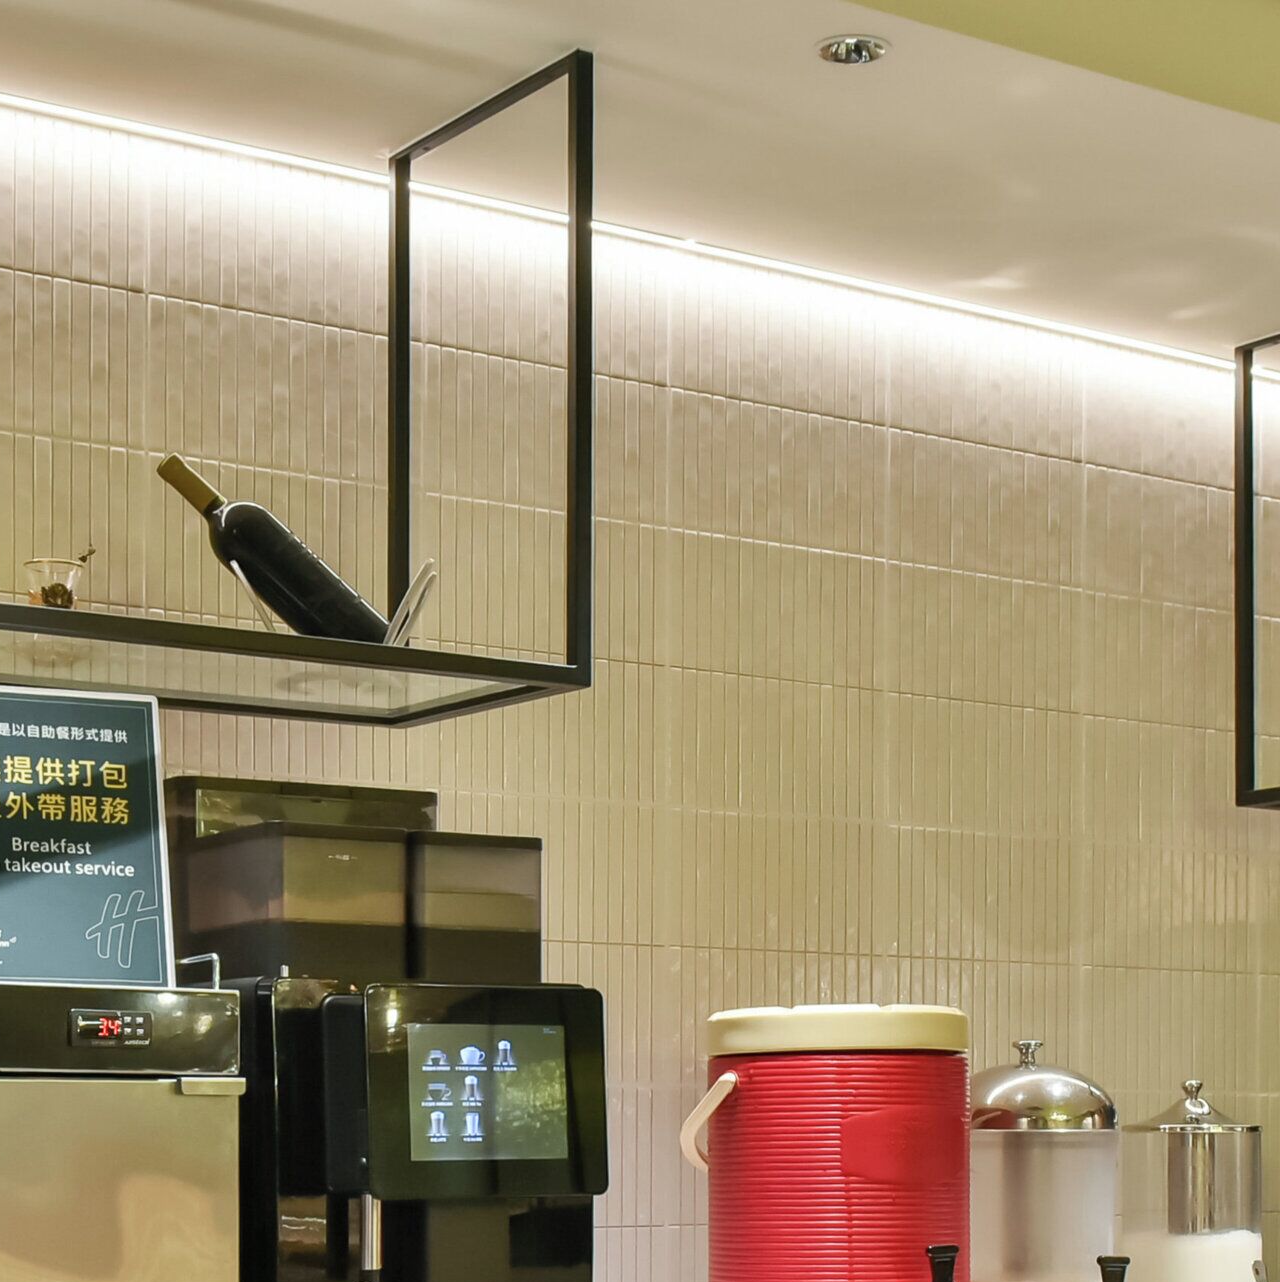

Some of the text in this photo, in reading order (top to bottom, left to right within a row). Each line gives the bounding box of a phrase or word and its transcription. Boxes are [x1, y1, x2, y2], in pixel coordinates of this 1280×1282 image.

[11, 837, 92, 856] Breakfast
[4, 858, 71, 875] takeout
[75, 861, 135, 877] service
